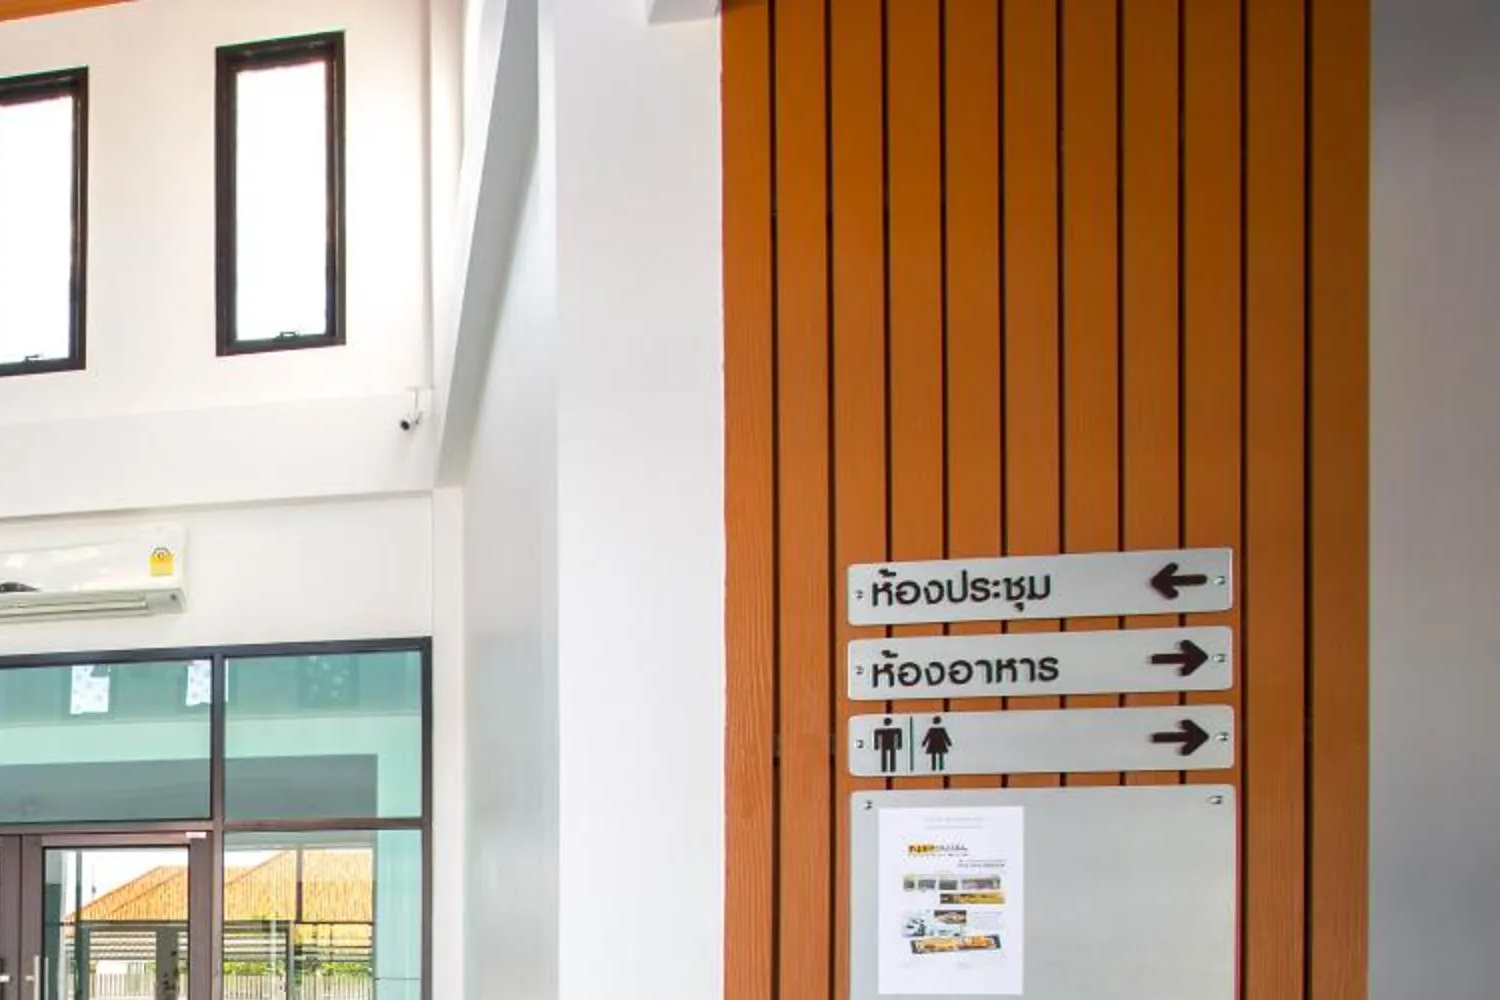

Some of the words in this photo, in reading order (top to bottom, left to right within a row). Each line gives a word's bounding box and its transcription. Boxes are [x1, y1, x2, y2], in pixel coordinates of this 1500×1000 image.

[872, 568, 1051, 612] ห้องประชุม
[872, 649, 1060, 688] ห้องอาหาร
